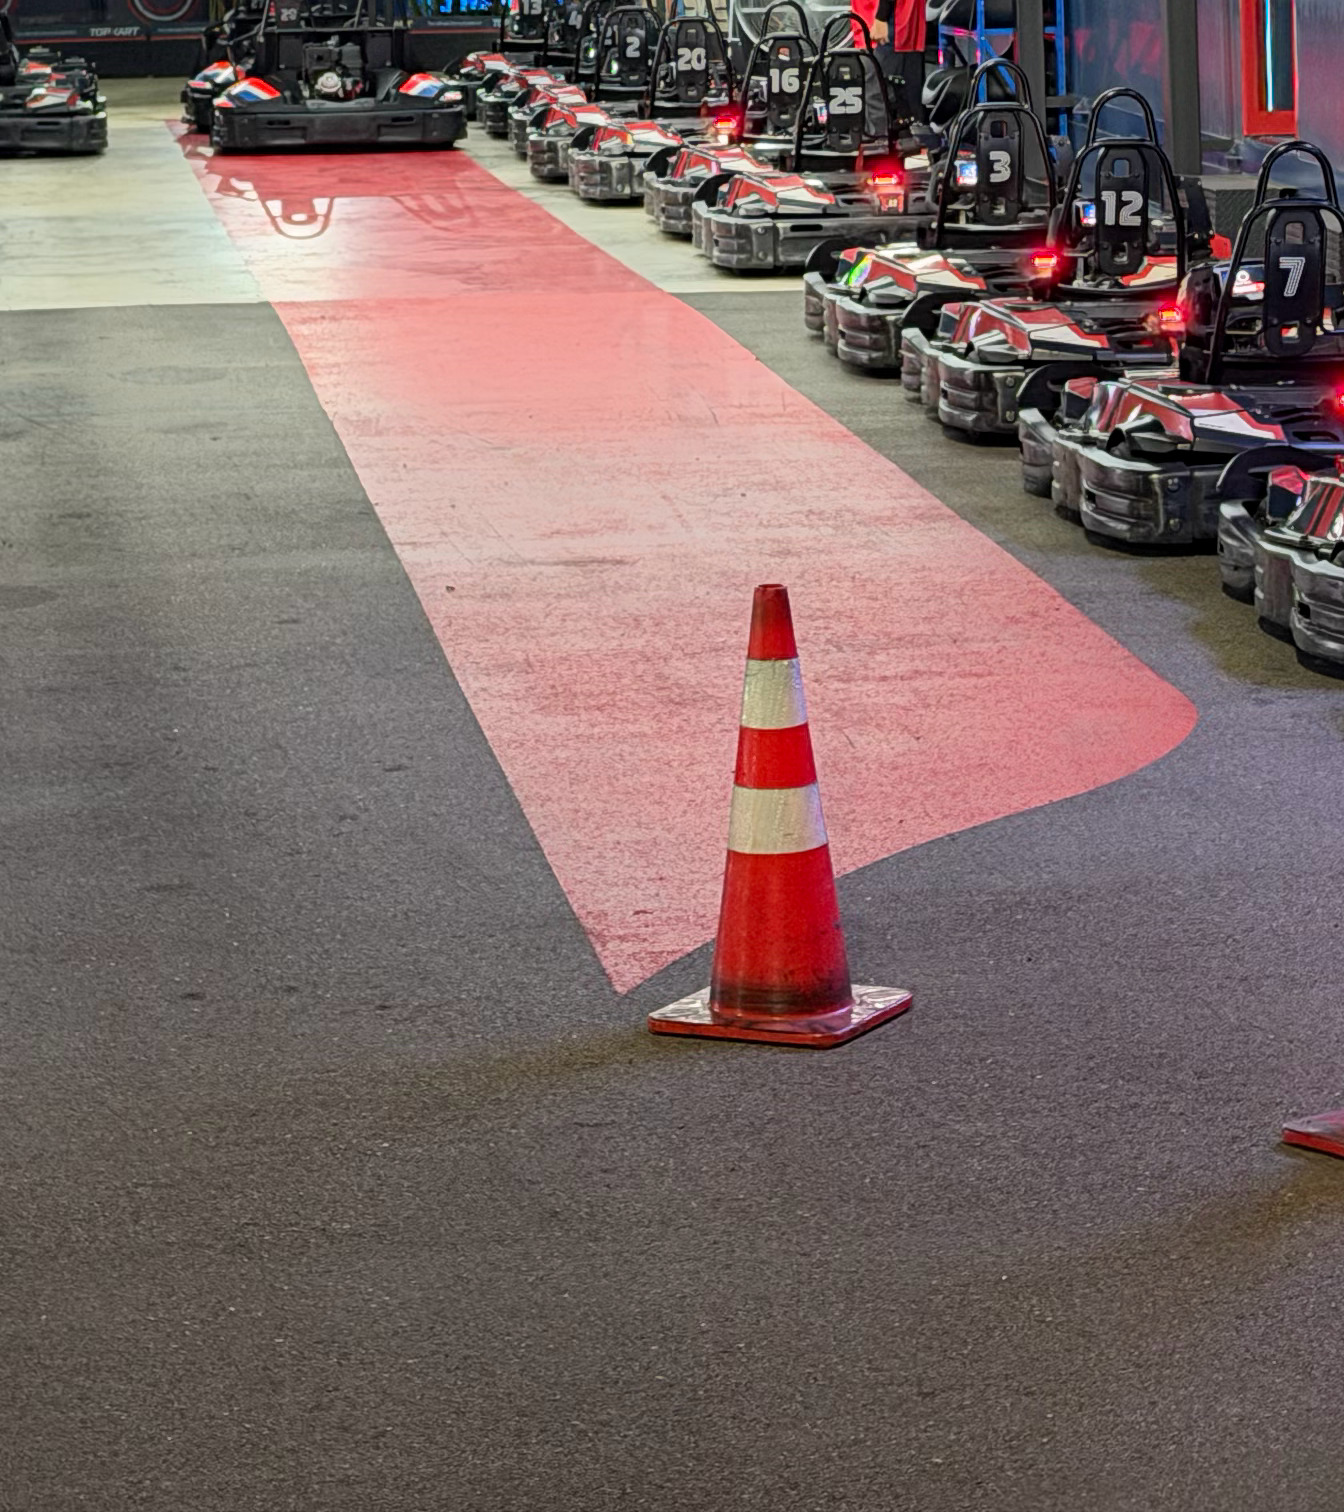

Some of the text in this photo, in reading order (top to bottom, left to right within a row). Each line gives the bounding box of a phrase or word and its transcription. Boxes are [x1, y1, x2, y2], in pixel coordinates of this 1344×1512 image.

[625, 36, 641, 58] 2
[677, 48, 706, 71] 20
[769, 68, 800, 93] 16
[828, 87, 863, 115] 25
[989, 150, 1011, 182] 3
[1101, 190, 1144, 226] 12
[1279, 256, 1305, 298] 7
